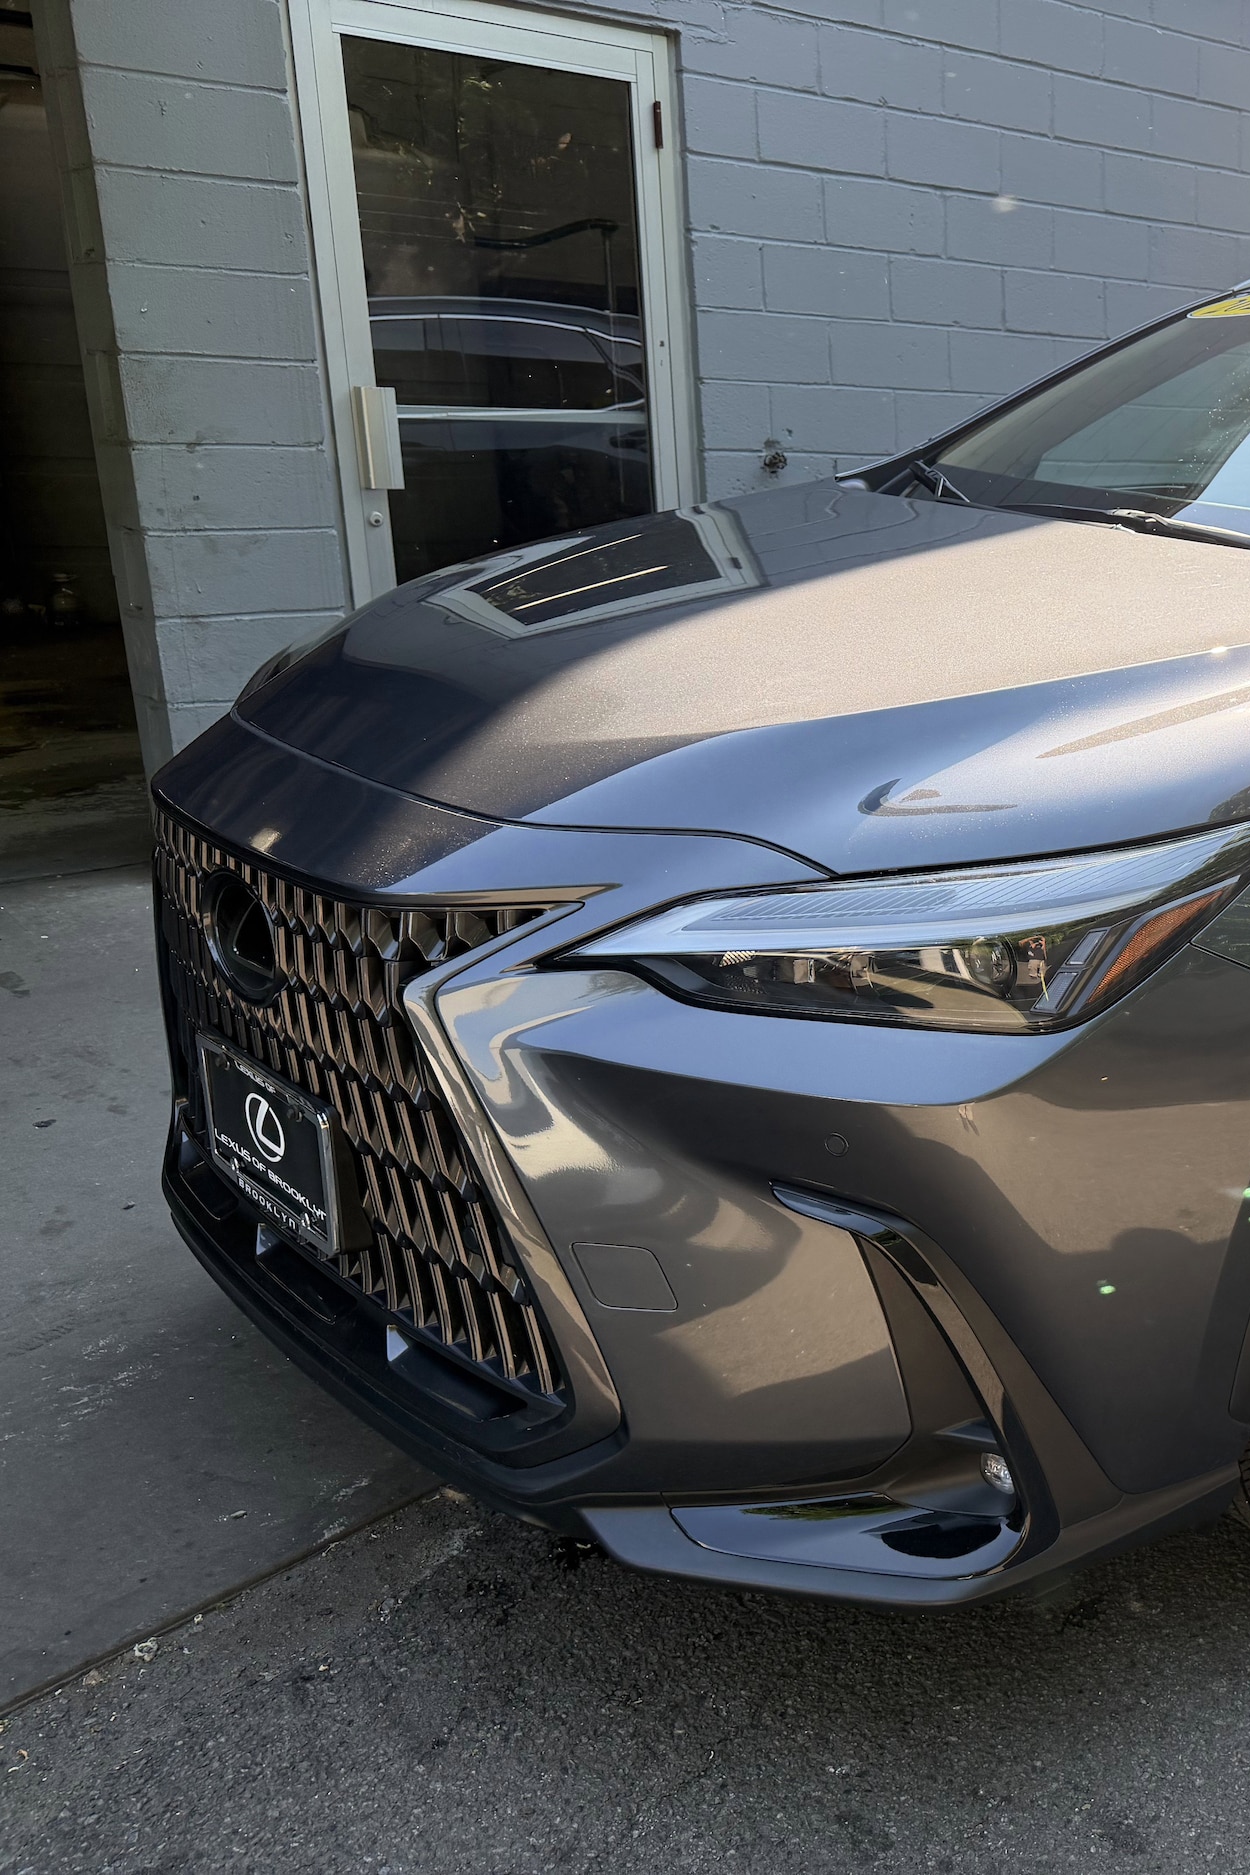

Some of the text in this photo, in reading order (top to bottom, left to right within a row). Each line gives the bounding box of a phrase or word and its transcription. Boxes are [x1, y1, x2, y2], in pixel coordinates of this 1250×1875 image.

[234, 1060, 276, 1094] LEXUS OF
[214, 1127, 252, 1162] LEXUS
[251, 1156, 267, 1172] OF
[238, 1177, 296, 1231] BROOKLYN
